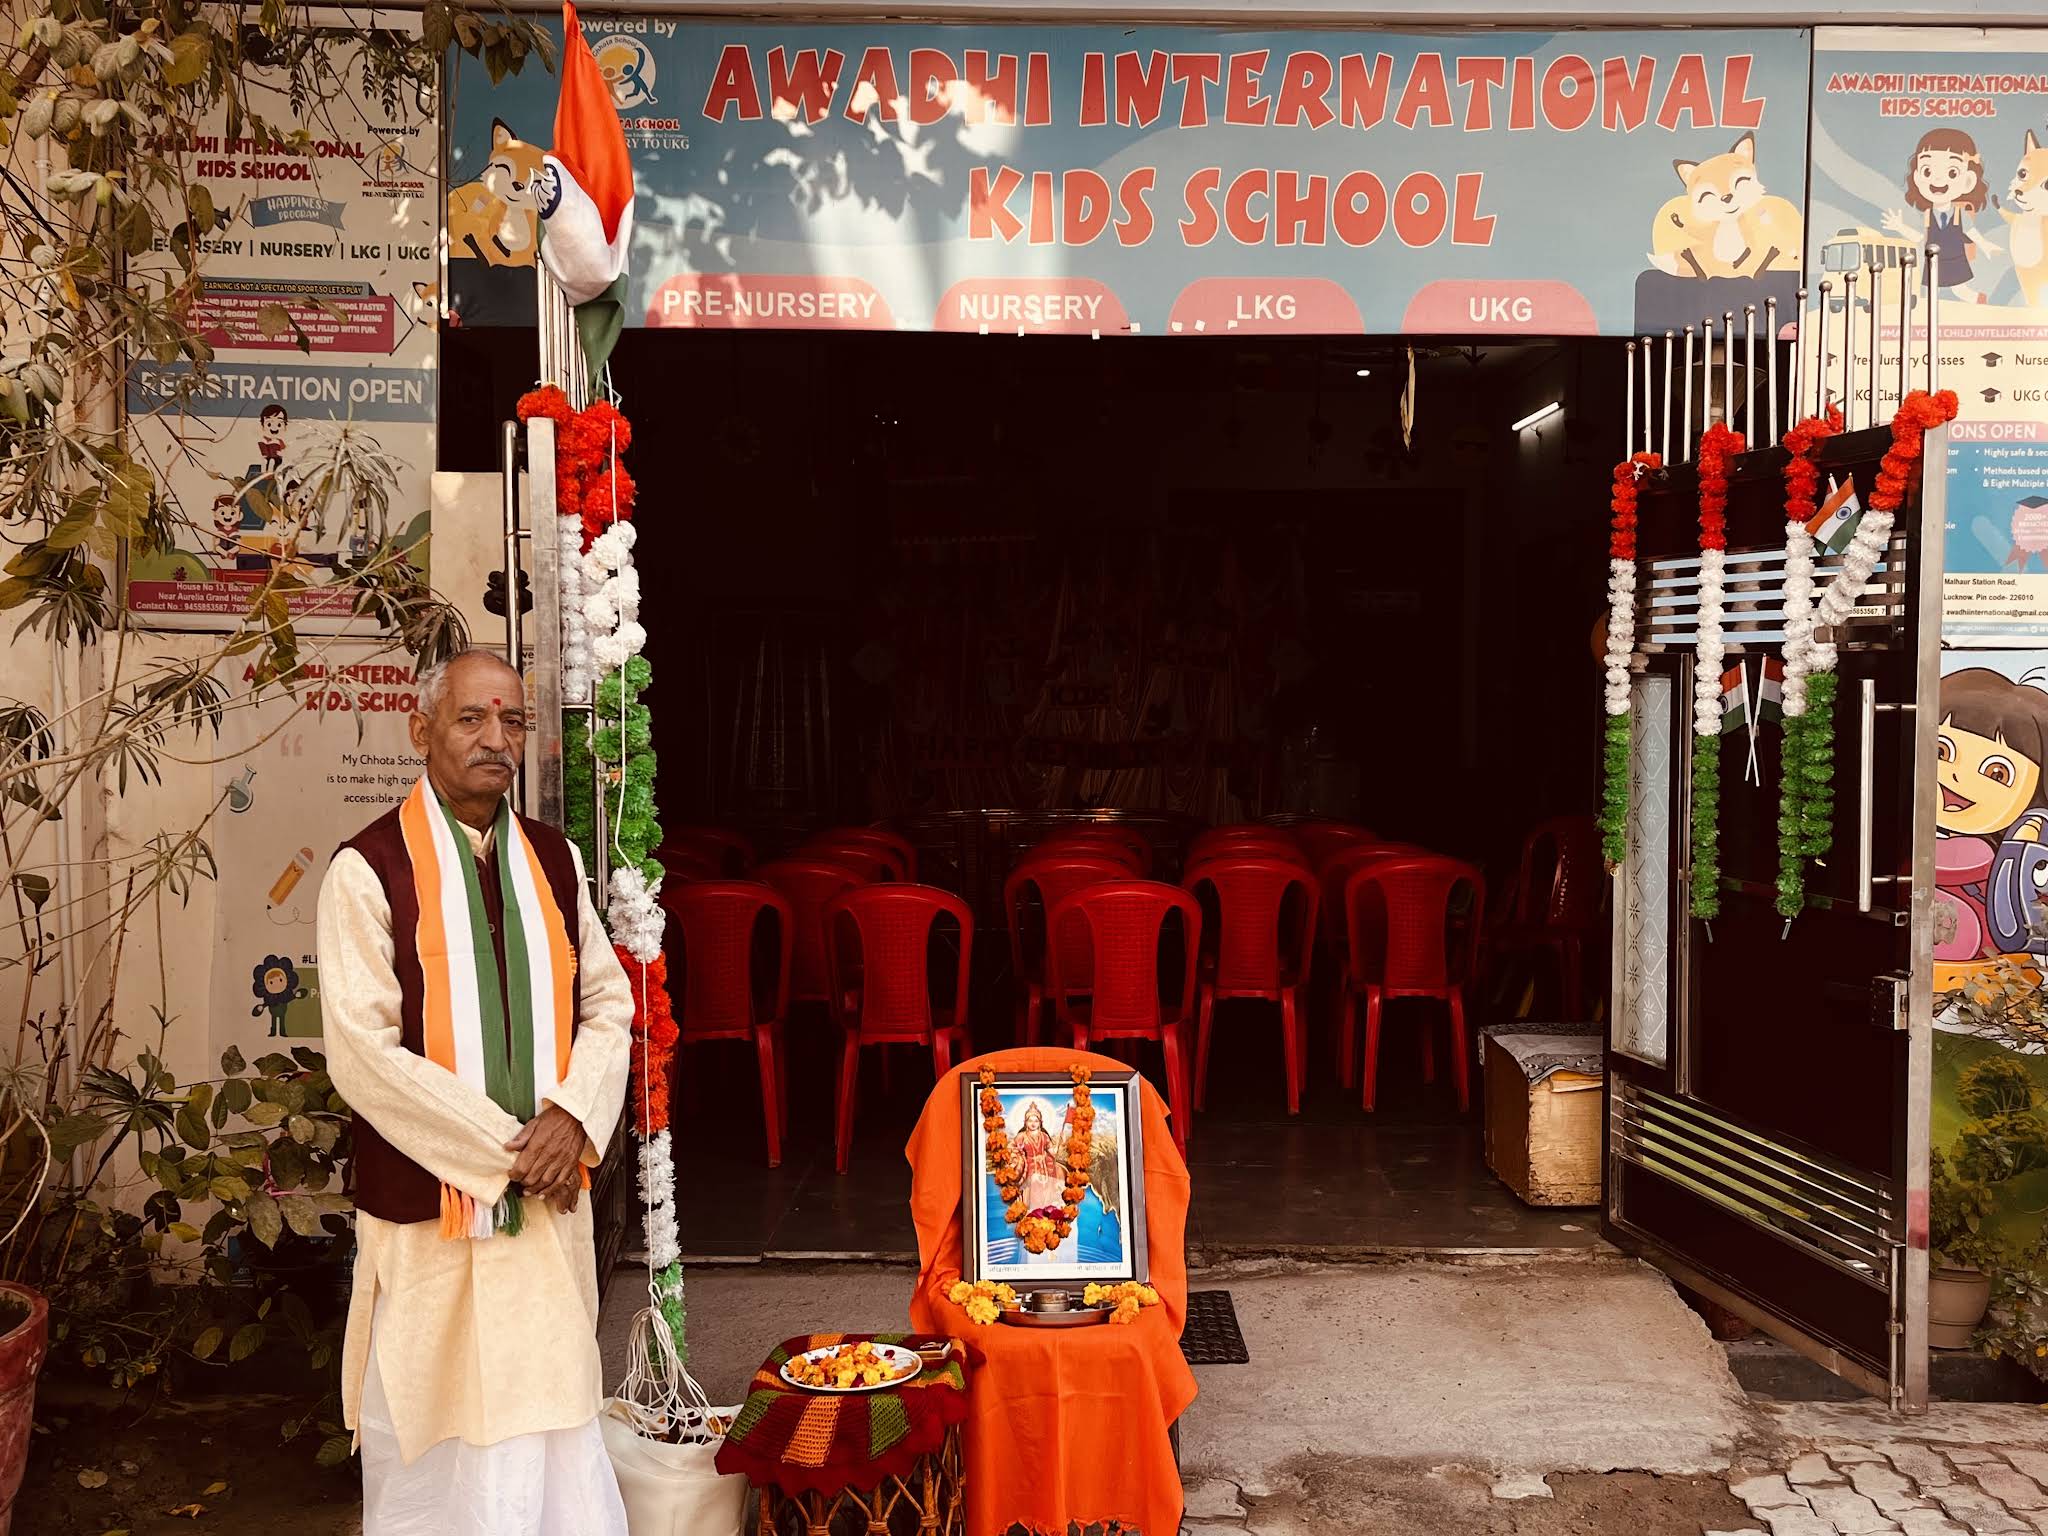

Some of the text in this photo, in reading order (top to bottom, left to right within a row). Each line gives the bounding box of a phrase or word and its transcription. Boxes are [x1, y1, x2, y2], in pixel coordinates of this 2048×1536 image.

[579, 18, 678, 39] owered by
[702, 44, 1766, 133] AWADHI INTERNATIONAL
[1826, 71, 2048, 95] AWADHI INTERNATIONAL
[1880, 98, 1997, 118] KIDS SCHOOL
[635, 117, 681, 132] SCHOOL
[367, 125, 420, 137] Powered by
[642, 138, 660, 149] TO
[663, 139, 690, 150] UKG
[197, 160, 312, 181] KIDS SCHOOL
[968, 165, 1497, 248] KIDS SCHOOL
[278, 210, 320, 221] PROGRAM
[260, 241, 334, 258] NURSERY
[351, 245, 381, 259] LKG
[397, 246, 430, 260] UKG
[204, 281, 233, 290] EARNING
[260, 283, 297, 293] SPECTATOR
[297, 285, 319, 293] SPORT
[345, 286, 362, 294] PLAY
[220, 298, 238, 307] HELP
[239, 299, 259, 308] YOUR
[663, 289, 877, 320] PRE-NURSERY
[959, 293, 1104, 321] NURSERY
[1235, 294, 1297, 321] LKG
[1469, 295, 1533, 323] UKG
[1944, 328, 1972, 338] CHILD
[1974, 329, 2034, 339] INTELLIGENT
[349, 376, 422, 405] OPEN
[2013, 390, 2041, 402] UKG
[1990, 424, 2037, 439] OPEN
[1984, 448, 2009, 458] Highly
[2010, 448, 2026, 457] safe
[2027, 448, 2034, 457] &
[1983, 466, 2016, 476] Methods
[2018, 467, 2040, 476] based
[1983, 479, 2045, 489] & Eight Multiple
[176, 582, 201, 591] House
[1944, 578, 1970, 586] Malhaur
[1972, 578, 1996, 586] Station
[158, 592, 176, 601] Near
[206, 593, 229, 602] Grand
[1976, 593, 1987, 601] Pin
[2009, 594, 2034, 602] 226010
[136, 601, 165, 610] Contact
[342, 755, 358, 766] My
[360, 754, 396, 766] Chhota
[327, 773, 335, 783] is
[337, 775, 348, 784] to
[350, 774, 375, 784] make
[377, 774, 399, 786] high
[344, 793, 394, 804] accessible
